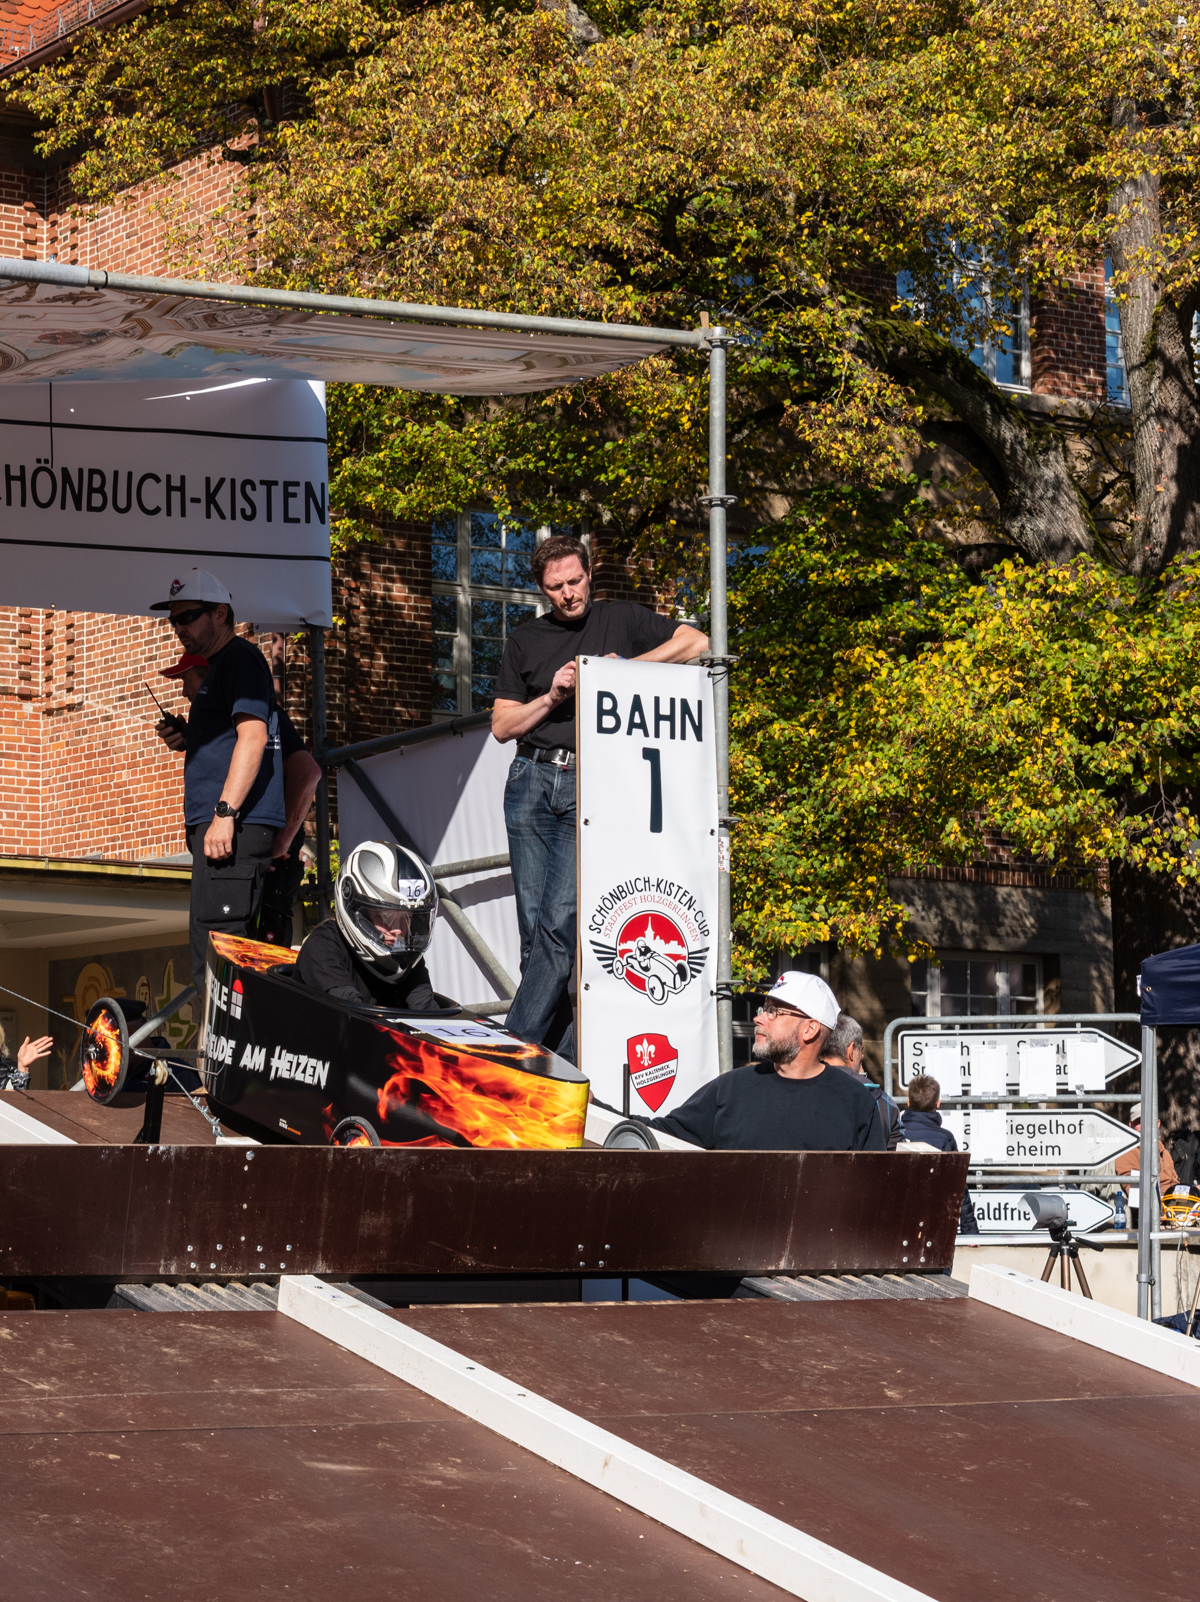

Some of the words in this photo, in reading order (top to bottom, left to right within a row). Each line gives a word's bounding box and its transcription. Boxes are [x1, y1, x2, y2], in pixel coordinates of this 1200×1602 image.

[596, 690, 703, 742] BAHN
[642, 747, 664, 833] 1
[406, 885, 421, 897] 16
[588, 876, 710, 937] SCHÖNBUCH-KISTEN-CUP
[603, 896, 638, 939] STADTFEST
[639, 894, 700, 942] HOLZGERLINGEN
[434, 1027, 492, 1038] 16
[239, 1043, 267, 1073] AM
[269, 1045, 331, 1090] HEIZEN
[645, 1063, 670, 1078] KALTENECK
[1005, 1119, 1084, 1139] iegelhof
